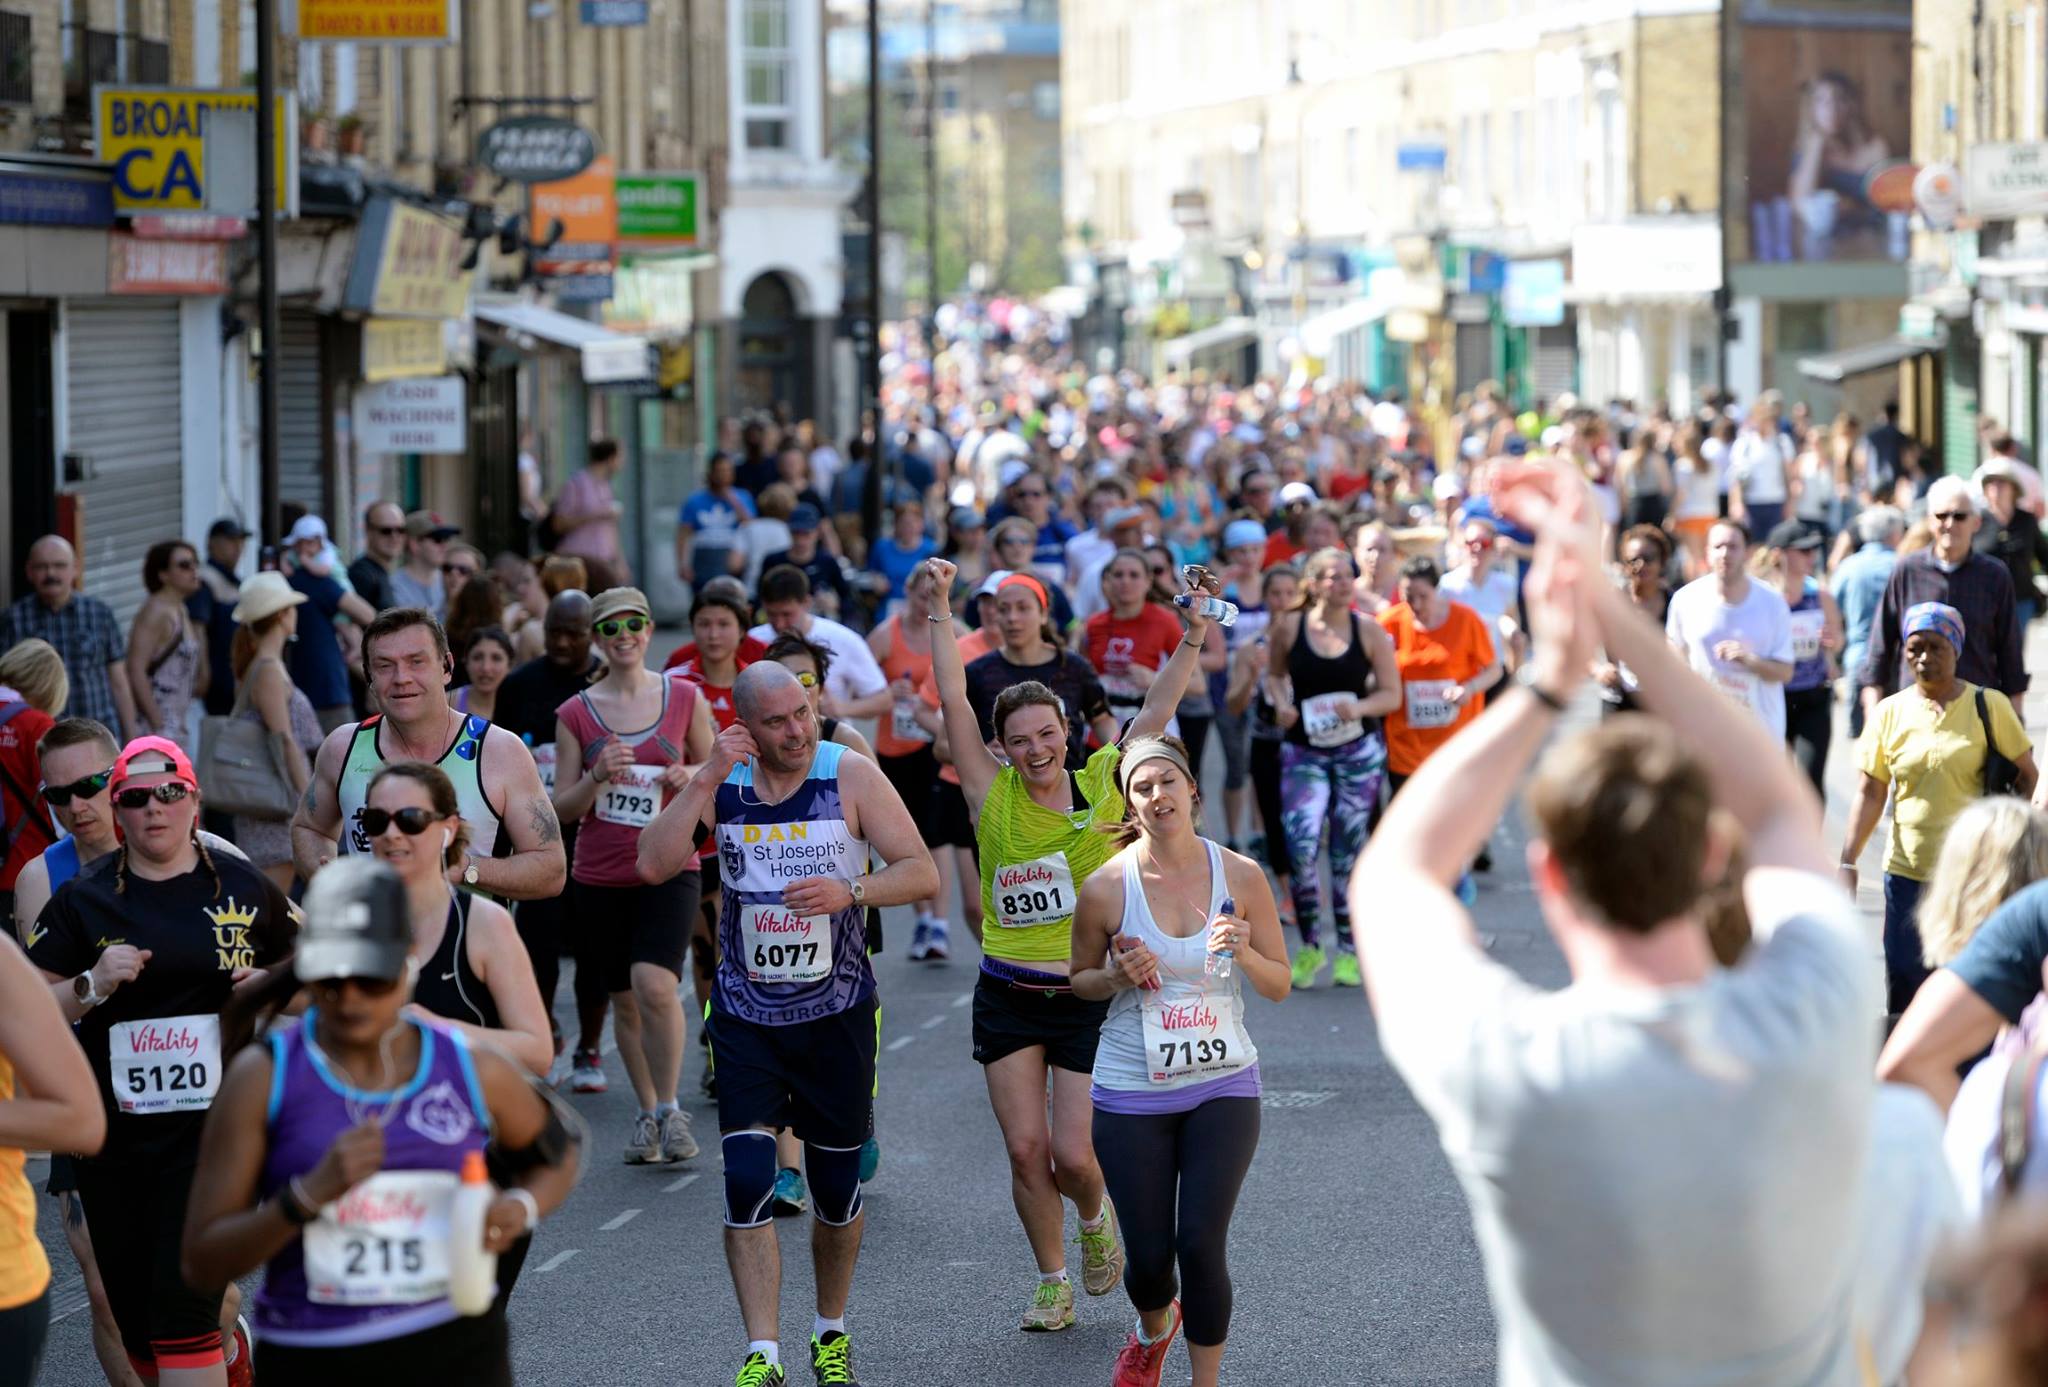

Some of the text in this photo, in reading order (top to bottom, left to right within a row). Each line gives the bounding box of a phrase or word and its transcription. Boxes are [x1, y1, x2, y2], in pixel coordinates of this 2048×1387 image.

[606, 791, 653, 815] 1793
[743, 822, 808, 843] DAN
[753, 840, 845, 860] St Joseph's
[770, 861, 836, 879] Hospice
[998, 866, 1053, 888] Vitality
[1001, 887, 1063, 915] 8301
[211, 926, 253, 949] UK
[754, 909, 811, 939] Vitality
[754, 942, 818, 968] 6077
[728, 969, 773, 1023] CHRISTI
[783, 990, 846, 1023] URGET
[1161, 1005, 1218, 1034] Vitality
[130, 1024, 199, 1058] Vitality
[1159, 1038, 1227, 1068] 7139
[127, 1062, 207, 1094] 5120
[344, 1238, 425, 1275] 215
